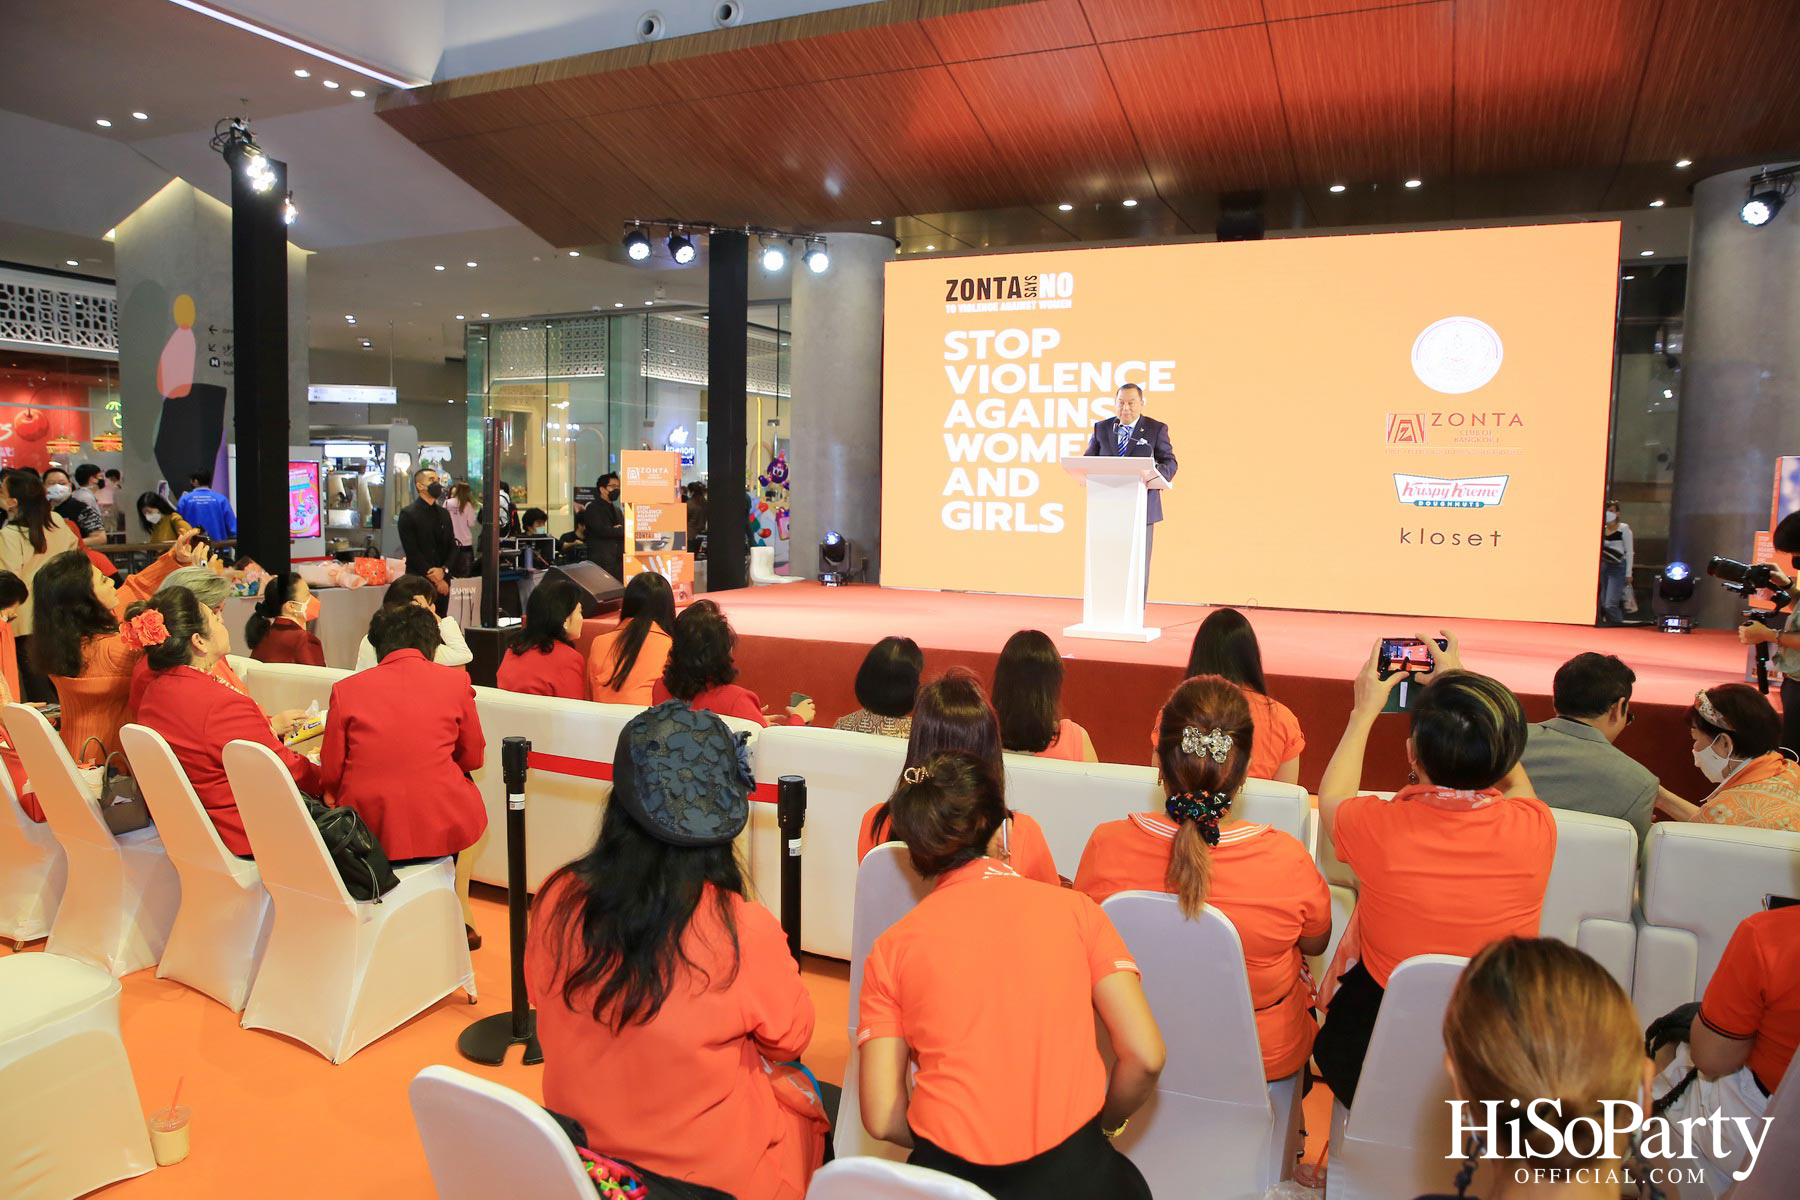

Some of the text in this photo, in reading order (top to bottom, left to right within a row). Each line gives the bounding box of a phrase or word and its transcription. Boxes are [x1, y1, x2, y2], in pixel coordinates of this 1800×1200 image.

[945, 271, 1074, 302] ZONTA SAYS NO
[945, 299, 1073, 314] TO VIOLENCE AGAINST WOMEN
[943, 327, 1061, 361] STOP
[943, 360, 1177, 394] VIOLENCE
[943, 397, 1147, 429] AGAINS
[1431, 412, 1524, 427] ZONTA
[943, 433, 1094, 463] WOME
[942, 467, 1040, 497] AND
[1402, 481, 1502, 499] Krispy Kreme
[941, 500, 1065, 533] GIRLS
[1400, 527, 1502, 547] kloset
